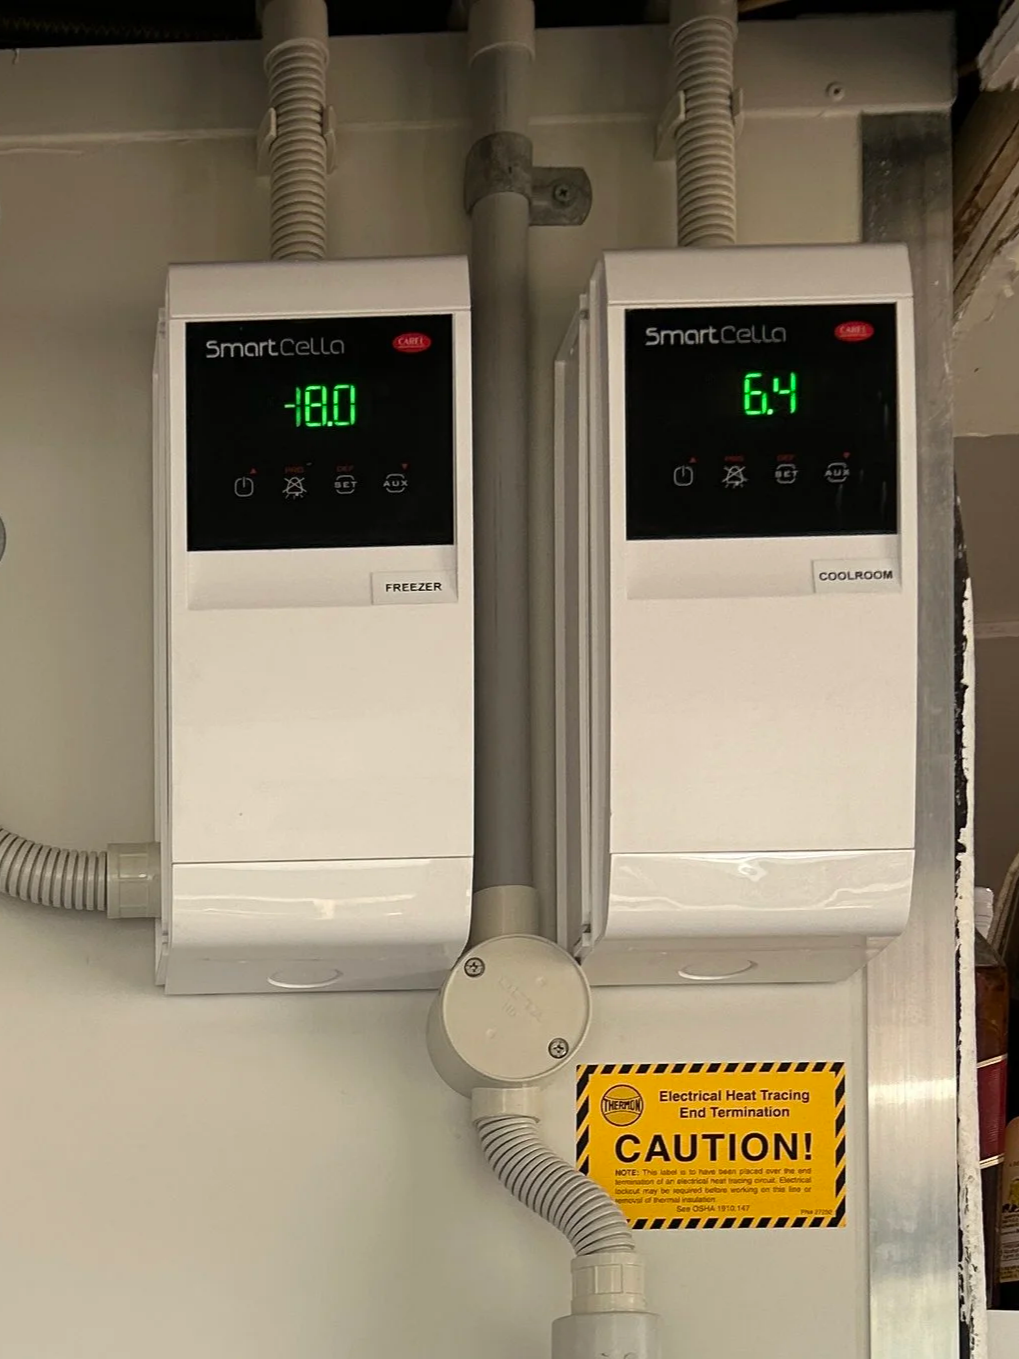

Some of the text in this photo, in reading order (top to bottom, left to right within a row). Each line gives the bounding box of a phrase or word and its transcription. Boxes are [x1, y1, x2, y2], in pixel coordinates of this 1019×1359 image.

[744, 371, 797, 416] 6.4
[284, 384, 356, 428] -18.0
[824, 469, 850, 477] AUX
[334, 481, 358, 489] SET
[383, 479, 408, 488] AUX
[819, 570, 893, 581] COOLROOM
[385, 582, 442, 592] FREEZER
[659, 1089, 810, 1103] Electrical Heat Tracing
[603, 1098, 642, 1113] THERMON
[680, 1106, 790, 1119] End Termination
[614, 1132, 813, 1163] CAUTION!
